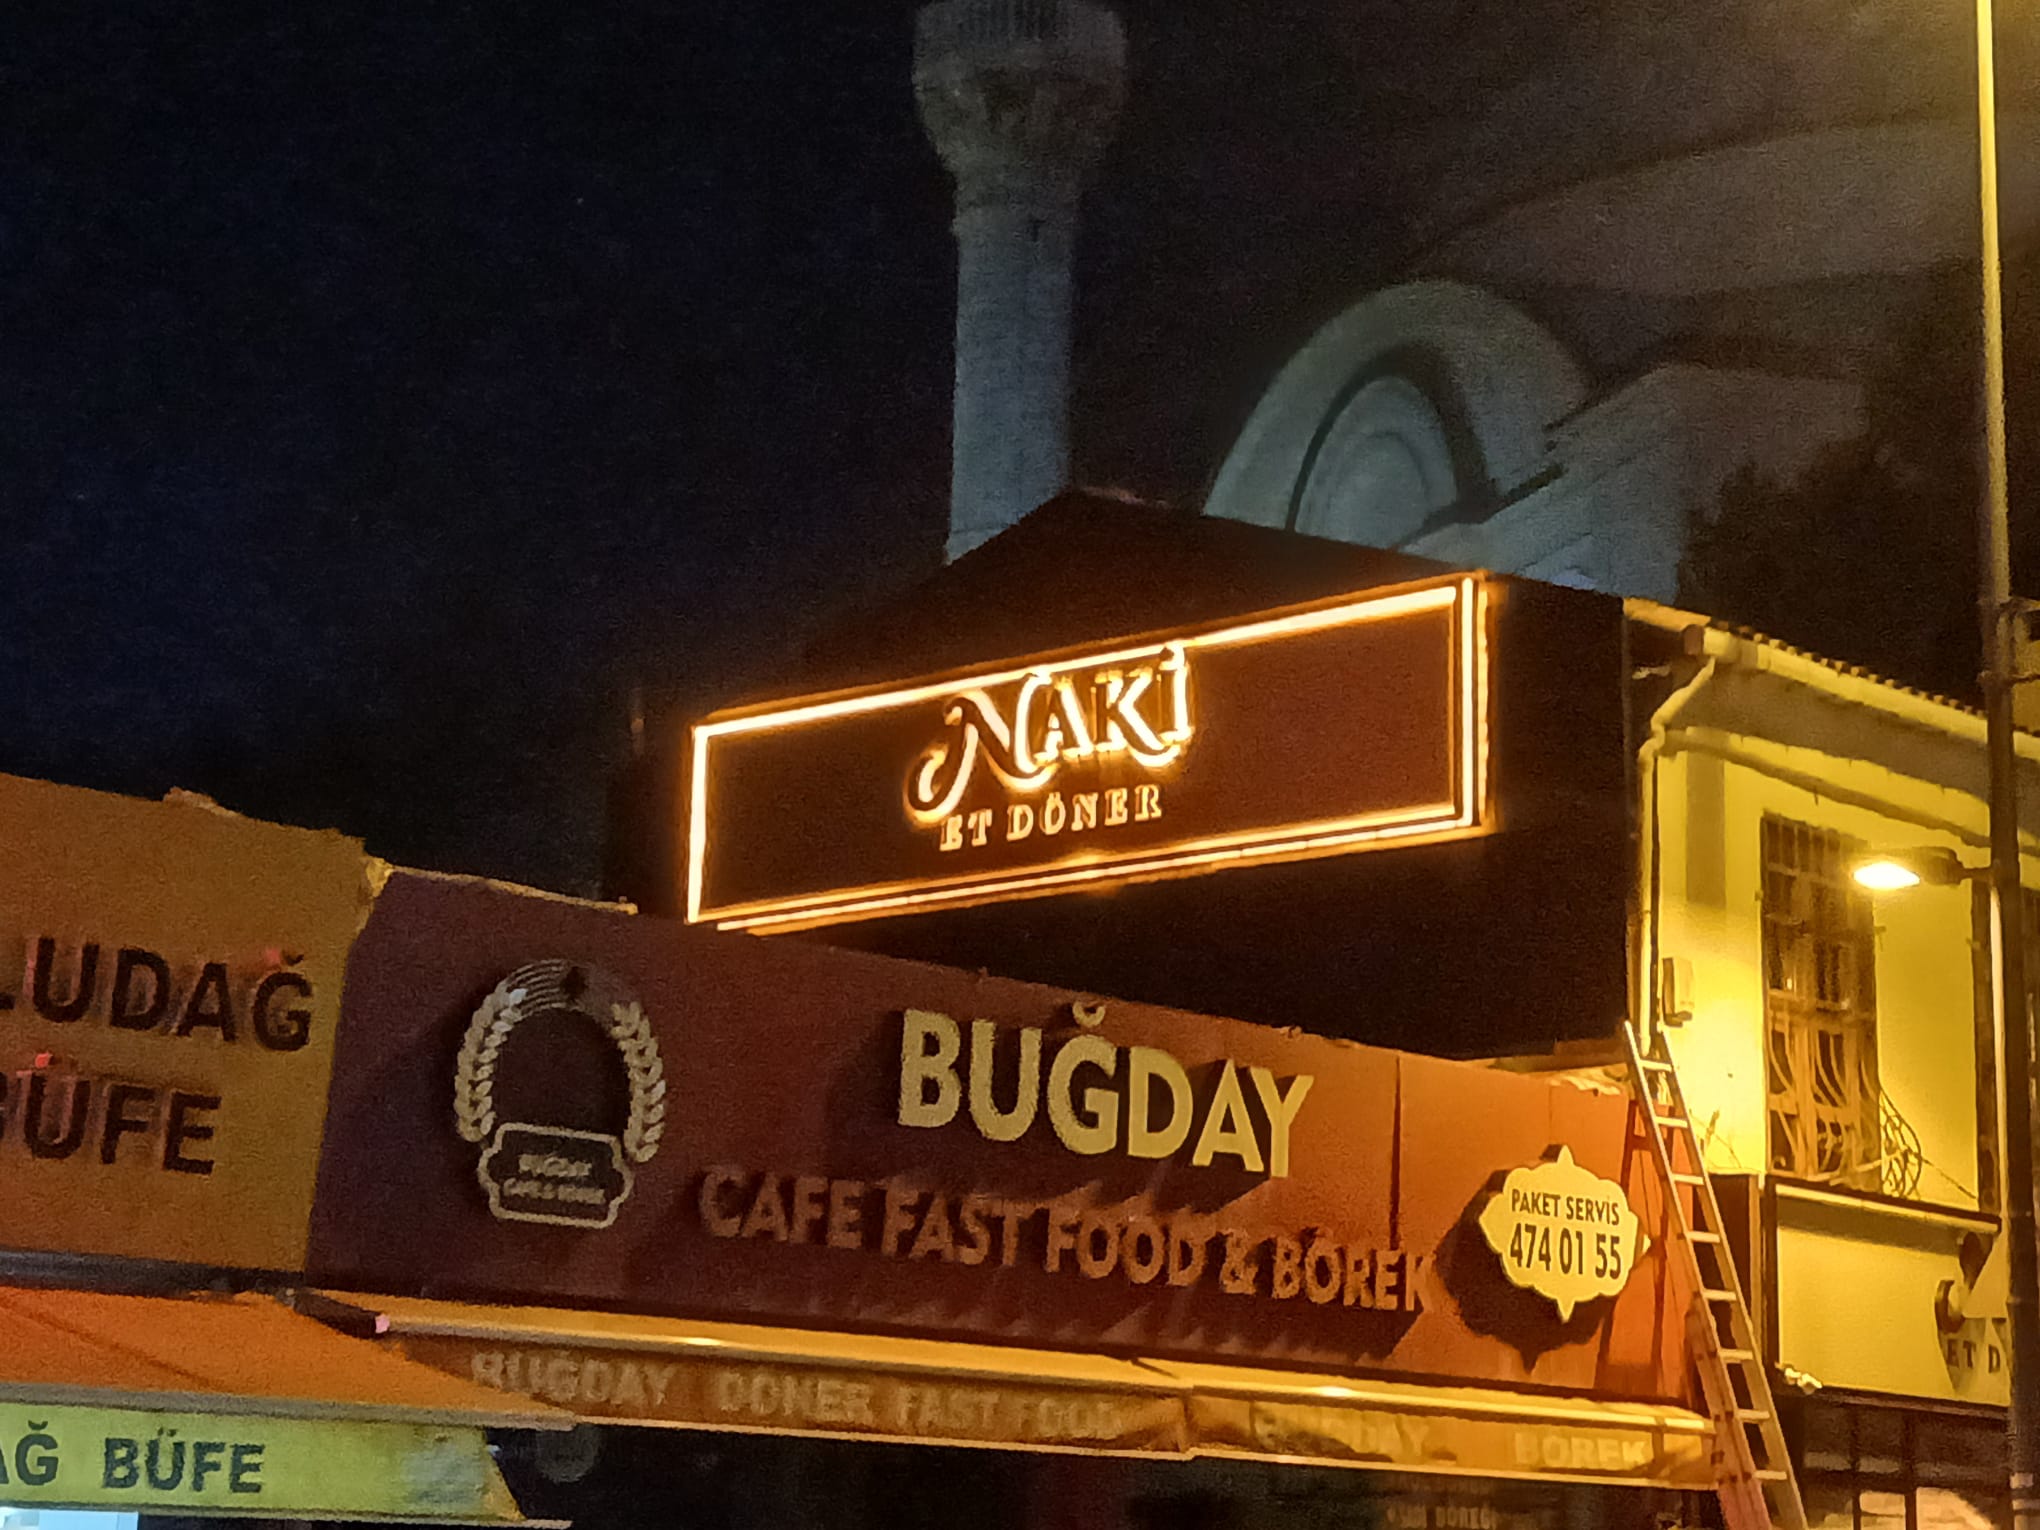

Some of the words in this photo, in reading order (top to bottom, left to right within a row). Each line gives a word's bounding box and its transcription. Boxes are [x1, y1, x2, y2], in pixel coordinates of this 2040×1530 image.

[939, 808, 992, 851] ET
[1006, 783, 1162, 841] DÖNER
[0, 934, 315, 1051] UDAĞ
[0, 1050, 222, 1175] ÜFE
[898, 1000, 1314, 1177] BUĞDAY
[701, 1166, 862, 1249] CAFE
[880, 1178, 1022, 1269] FAST
[1044, 1206, 1206, 1288] FOOD
[1220, 1228, 1257, 1295] &
[1510, 1222, 1552, 1272] 474
[1559, 1227, 1583, 1275] 01
[1595, 1233, 1621, 1280] 55
[1511, 1188, 1561, 1217] PAKET
[1566, 1194, 1620, 1226] SERVİS
[0, 1420, 59, 1486] Ğ
[102, 1427, 265, 1493] BÜFE
